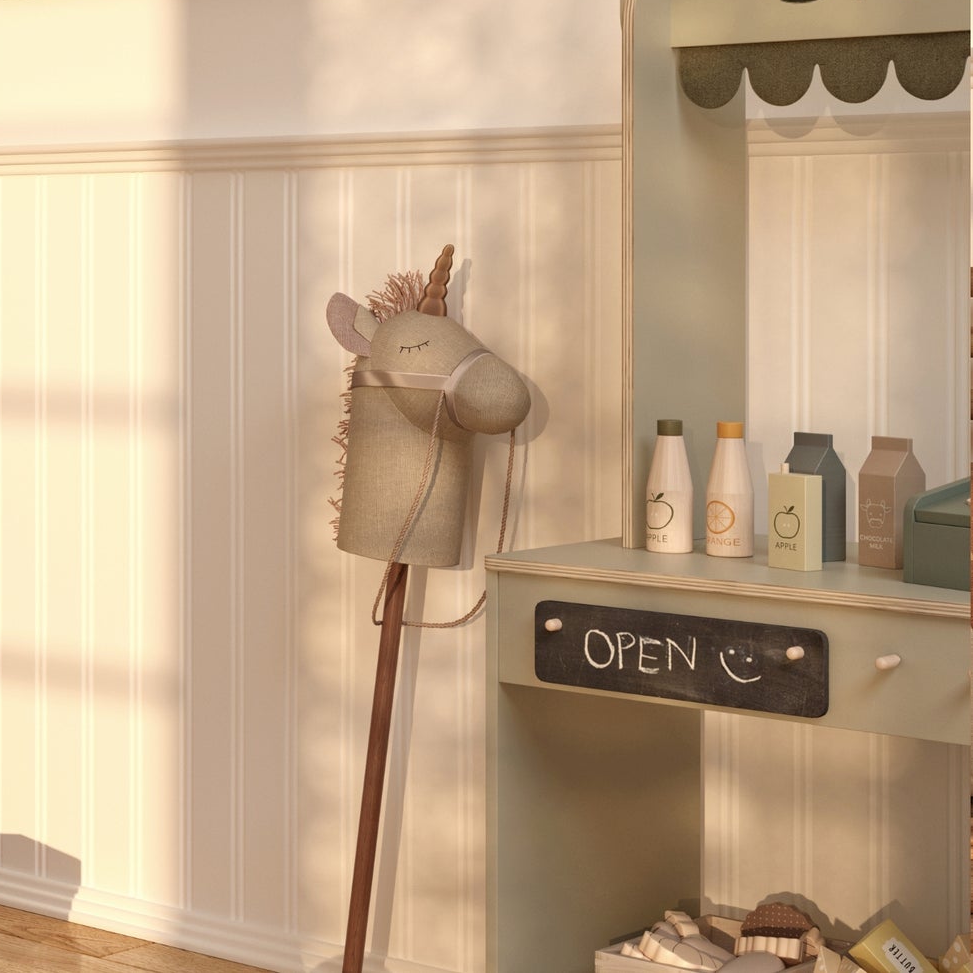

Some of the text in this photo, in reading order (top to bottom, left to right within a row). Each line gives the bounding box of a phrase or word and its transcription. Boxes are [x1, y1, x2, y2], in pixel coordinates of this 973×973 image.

[859, 534, 893, 543] CHOCOLATE
[775, 542, 797, 551] APPLE
[868, 542, 884, 550] MILK
[584, 629, 697, 674] OPEN
[888, 944, 916, 973] BUTTER
